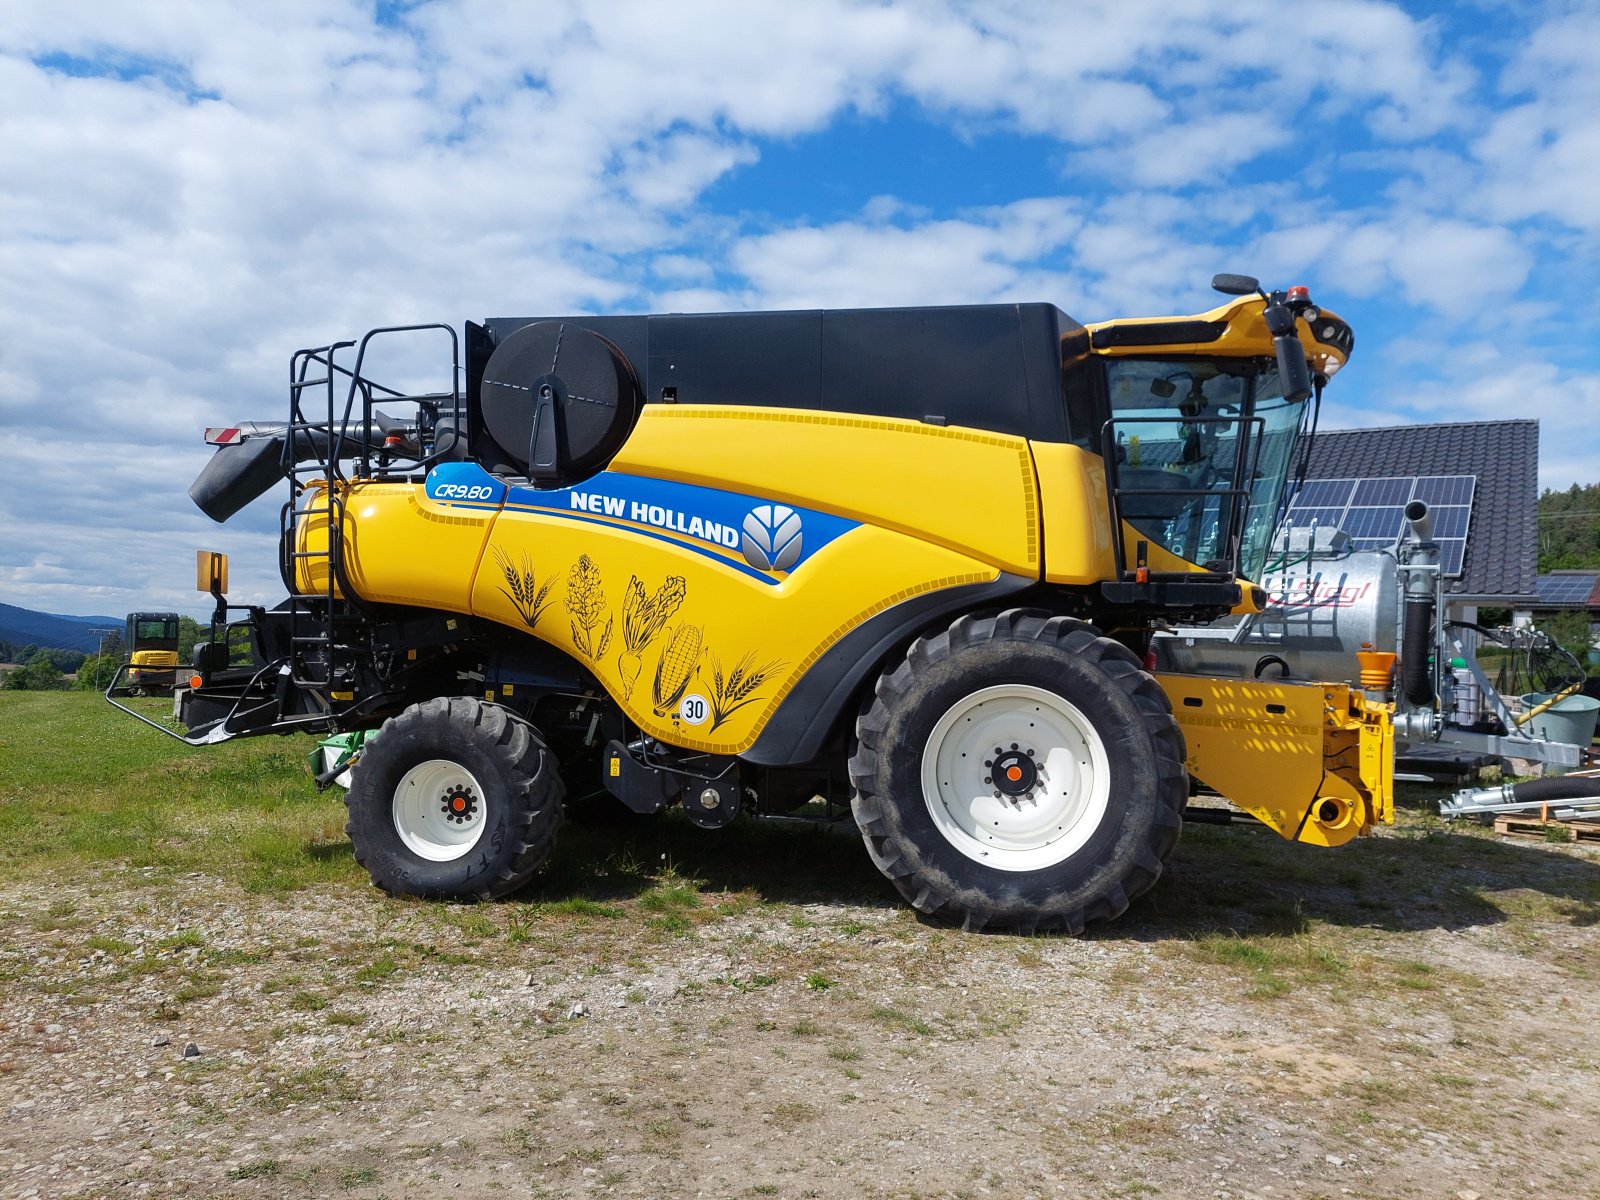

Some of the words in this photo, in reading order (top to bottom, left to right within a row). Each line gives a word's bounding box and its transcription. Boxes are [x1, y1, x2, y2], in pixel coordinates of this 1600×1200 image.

[434, 484, 493, 500] CR9.80
[570, 491, 626, 517] NEW
[631, 501, 739, 548] HOLLAND
[685, 700, 704, 719] 30
